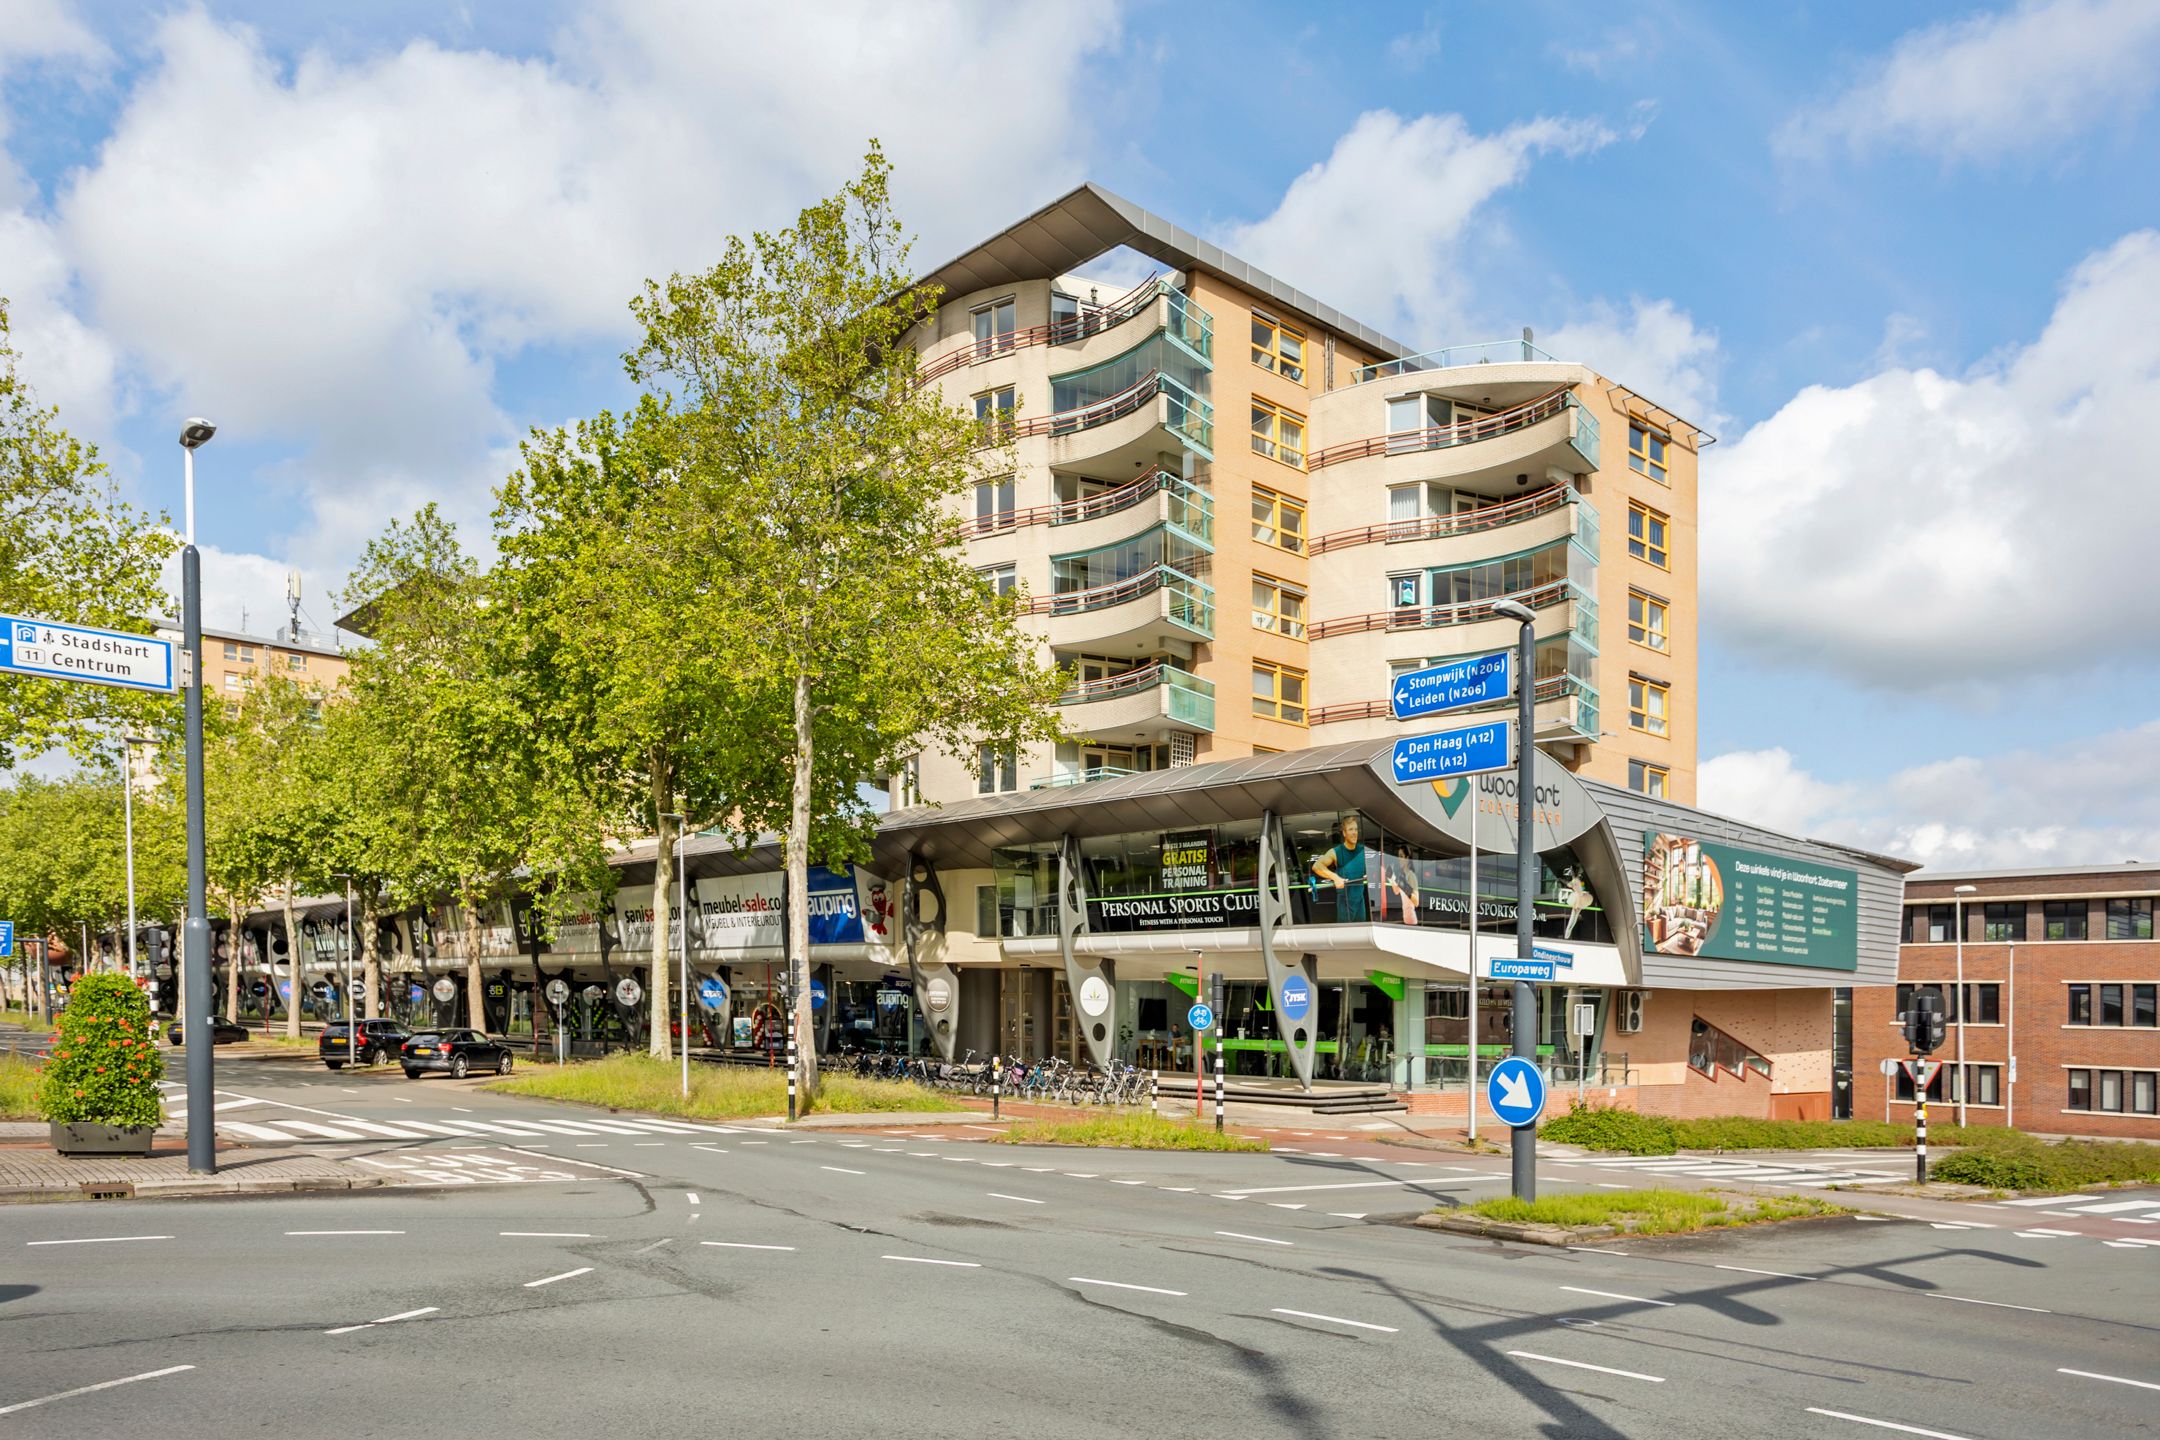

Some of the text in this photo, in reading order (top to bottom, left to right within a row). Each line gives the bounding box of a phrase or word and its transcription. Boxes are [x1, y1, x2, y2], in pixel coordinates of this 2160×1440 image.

[62, 634, 149, 658] Stadshart
[25, 650, 39, 661] 11
[52, 652, 131, 676] Centrum
[1409, 667, 1465, 690] Stompwijk
[1409, 692, 1445, 708] Leiden
[1409, 728, 1494, 755] Den Haag (A12)
[1409, 752, 1467, 773] Delft (A12)
[1480, 774, 1561, 807] wooart
[1162, 849, 1208, 866] GRATIS!
[1162, 865, 1208, 878] PERSONAL
[1735, 861, 1750, 874] Deze
[1750, 864, 1770, 877] winkels
[1162, 876, 1208, 889] TRAINING
[703, 893, 781, 915] meubel-sale.co
[808, 894, 856, 921] auping
[1101, 900, 1167, 918] PERSONAL
[1169, 897, 1220, 914] SPORTS
[1493, 962, 1550, 978] Europaweg
[876, 993, 909, 1009] auping
[1290, 992, 1307, 1002] JYSK
[401, 1166, 577, 1184] BUS
